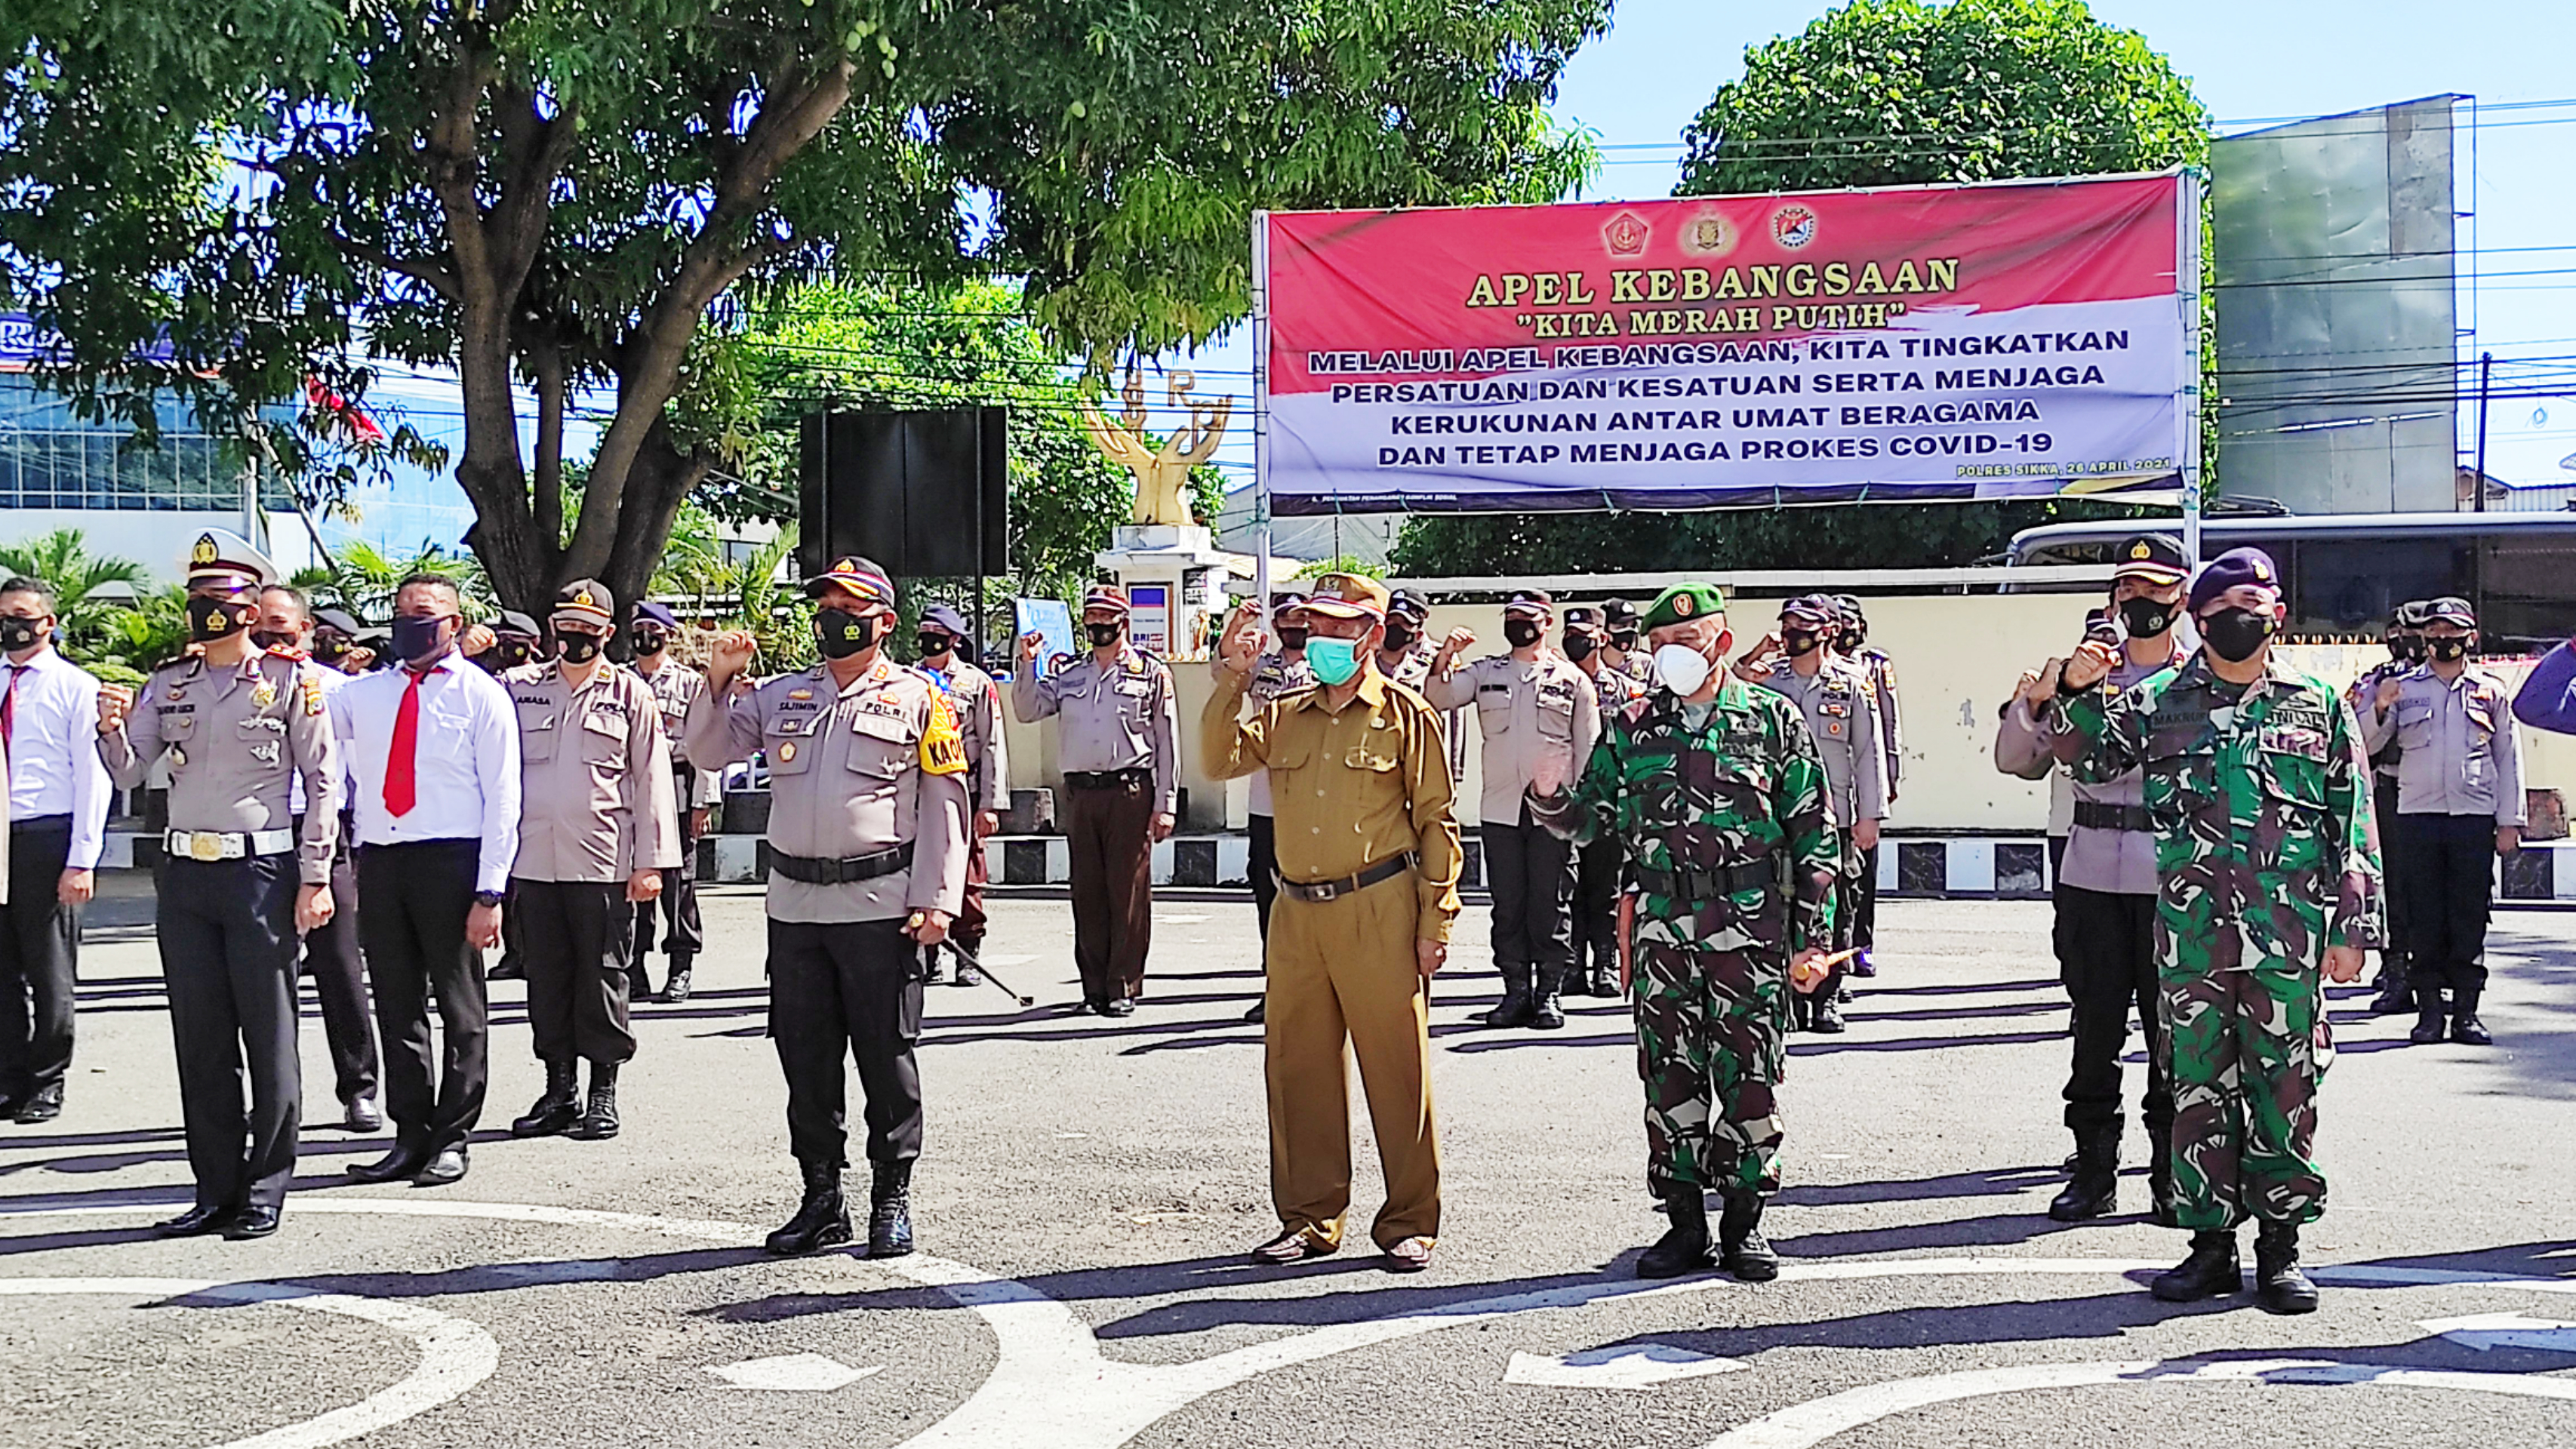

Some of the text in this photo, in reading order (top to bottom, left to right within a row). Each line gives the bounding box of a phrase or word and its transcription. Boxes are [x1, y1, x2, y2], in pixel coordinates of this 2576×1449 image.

[1467, 258, 1959, 306] APEL KEBANGSAAN
[1629, 307, 1761, 335] MERAH
[1310, 330, 2129, 372] MELALUI APEL KEBANGSAAN, KITA TINGKATKAN
[1332, 365, 2106, 404] PERSATUAN DAN KESATUAN SERTA MENJAGA
[1391, 401, 2040, 435] KERUKUNAN ANTAR UMAT BERAGAMA
[1378, 432, 2053, 466] DAN TETAP MENJAGA PROKES COVID-19
[1957, 457, 2171, 477] POLRES SIKKA, 26 APRIL 2021
[866, 702, 907, 719] POLRI
